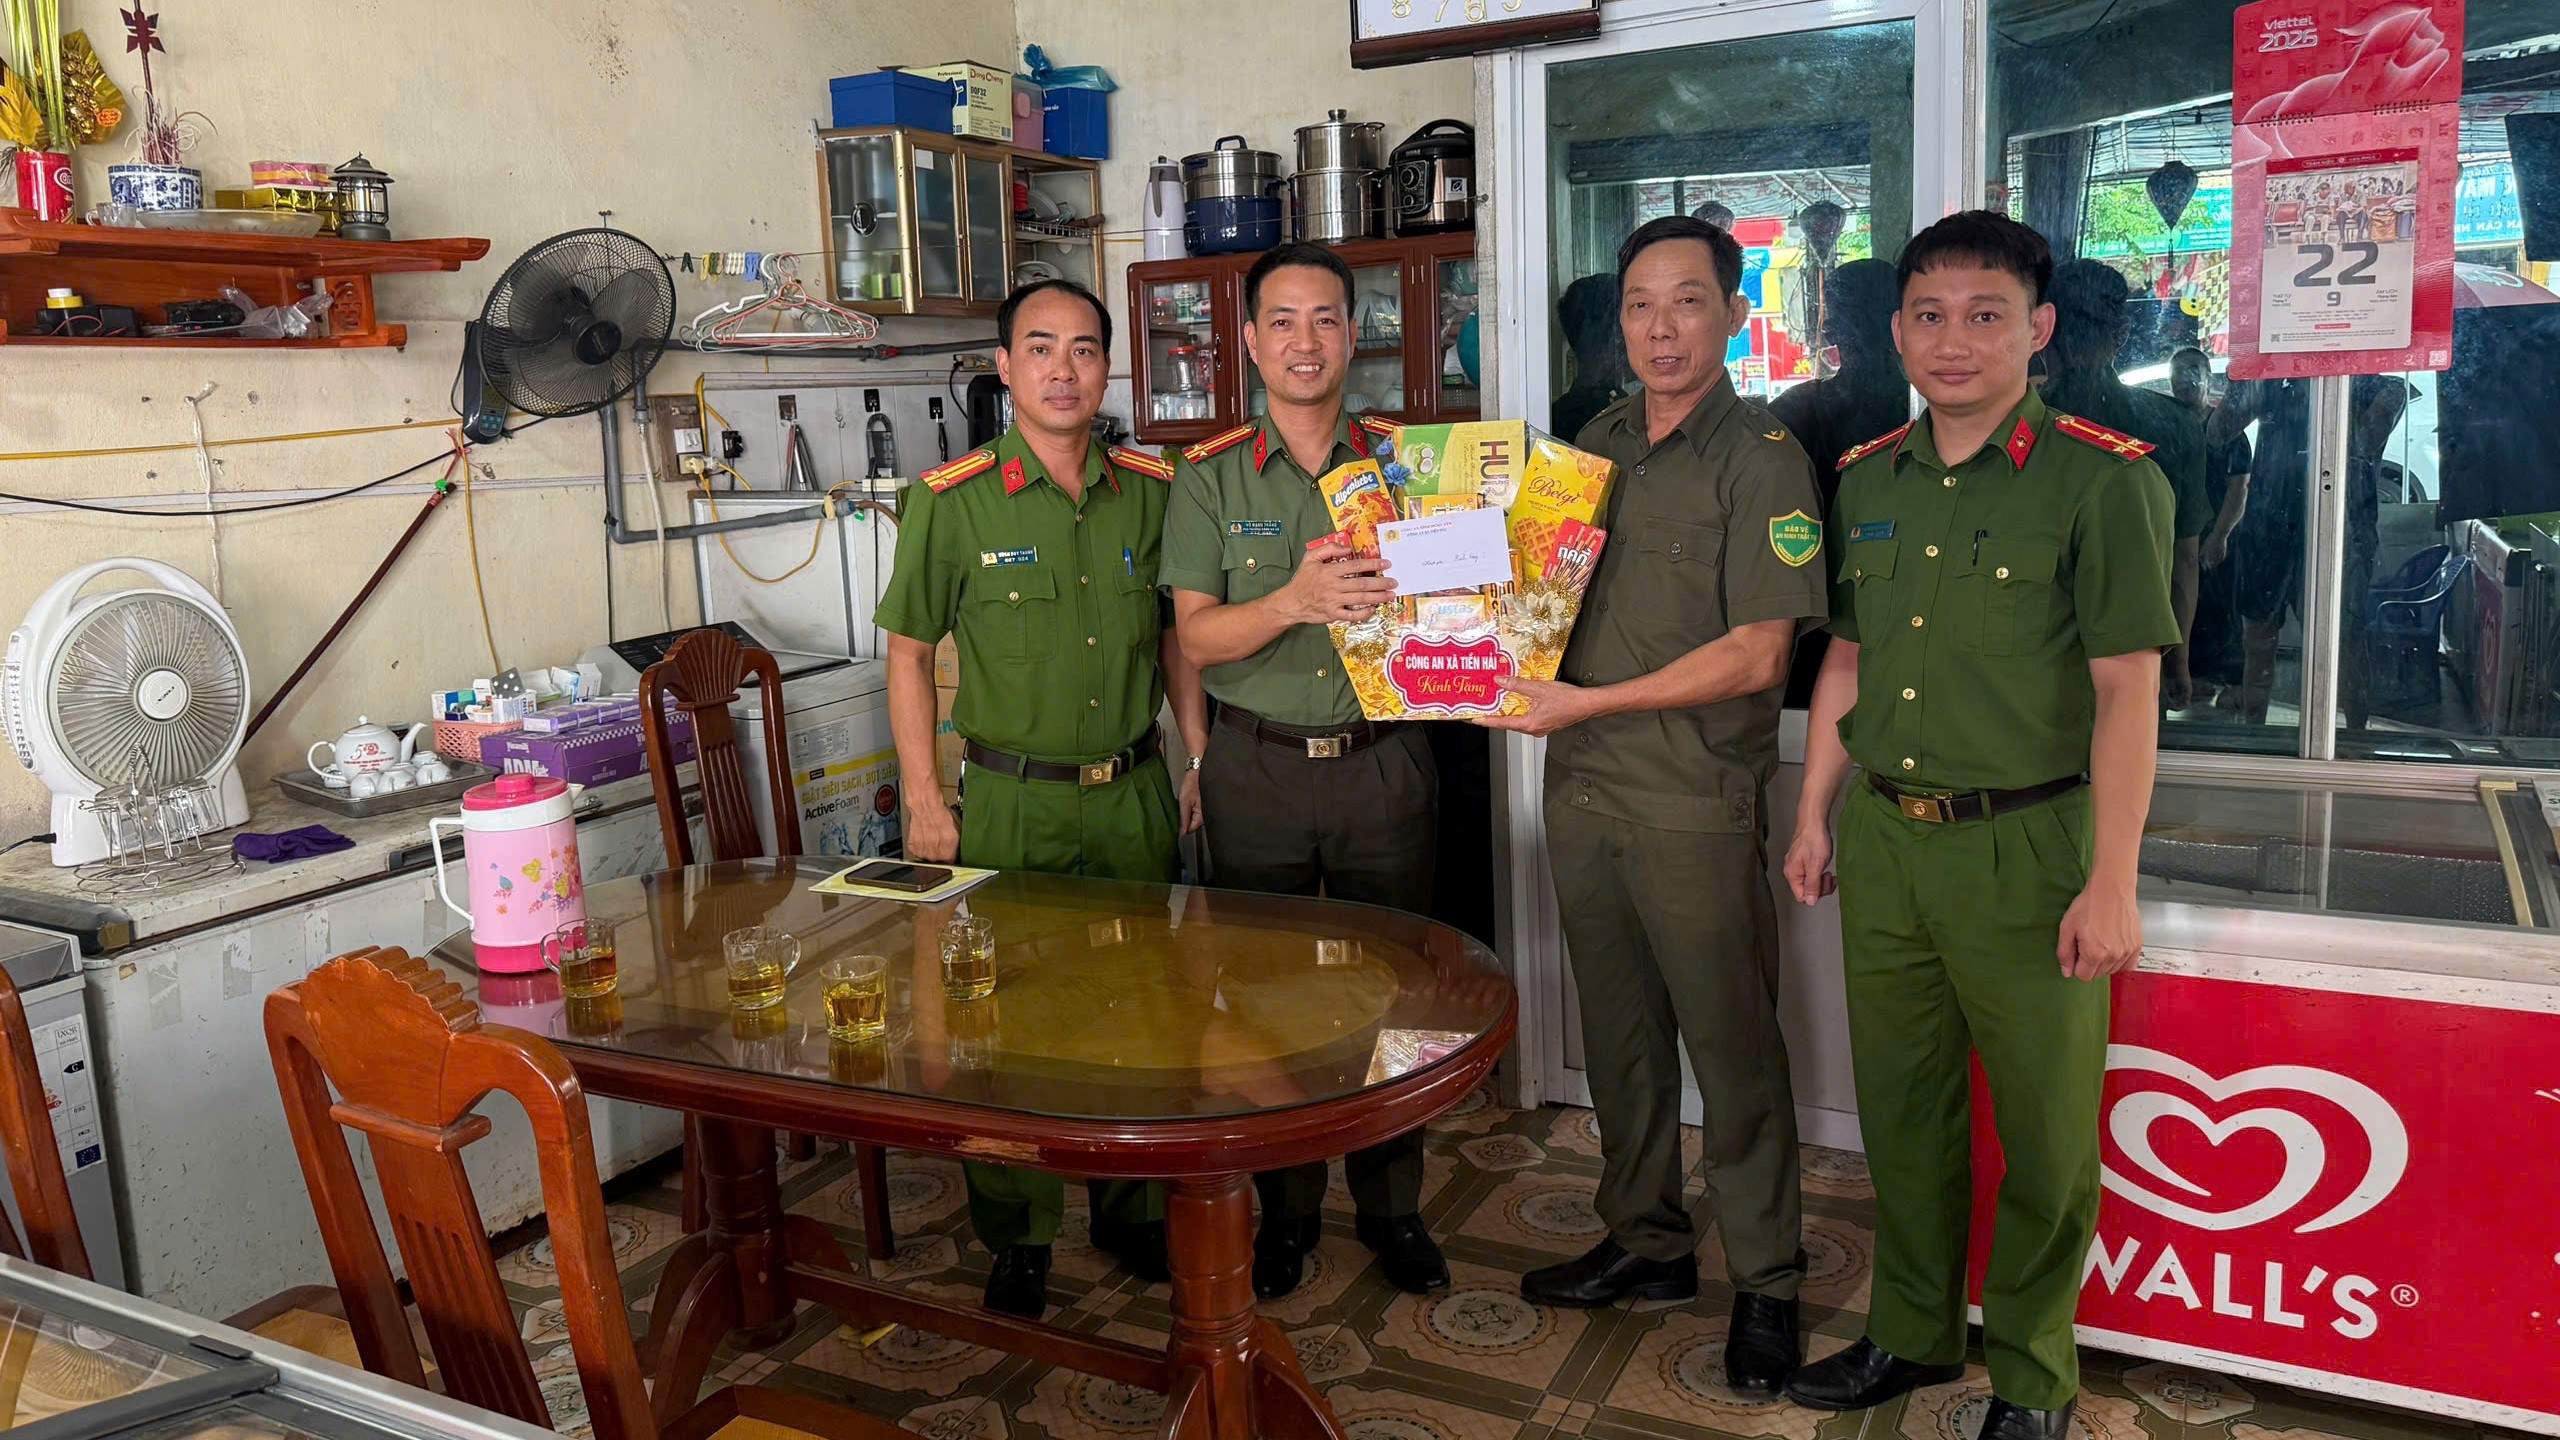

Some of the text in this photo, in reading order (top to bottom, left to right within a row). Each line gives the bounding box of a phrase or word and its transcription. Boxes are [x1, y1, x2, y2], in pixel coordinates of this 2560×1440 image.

[2264, 15, 2314, 30] viettel
[2258, 28, 2318, 52] 2026
[2293, 241, 2379, 287] 22
[2326, 291, 2341, 307] 9
[1333, 472, 1374, 507] Alpenliebe
[1528, 475, 1584, 507] Belgi
[1405, 653, 1430, 670] CÔNG
[1432, 656, 1444, 670] AN
[1446, 653, 1459, 670] XÃ
[1482, 652, 1498, 670] HẢI
[1417, 675, 1487, 697] Kính Tặng
[804, 795, 859, 821] ActiveFoam
